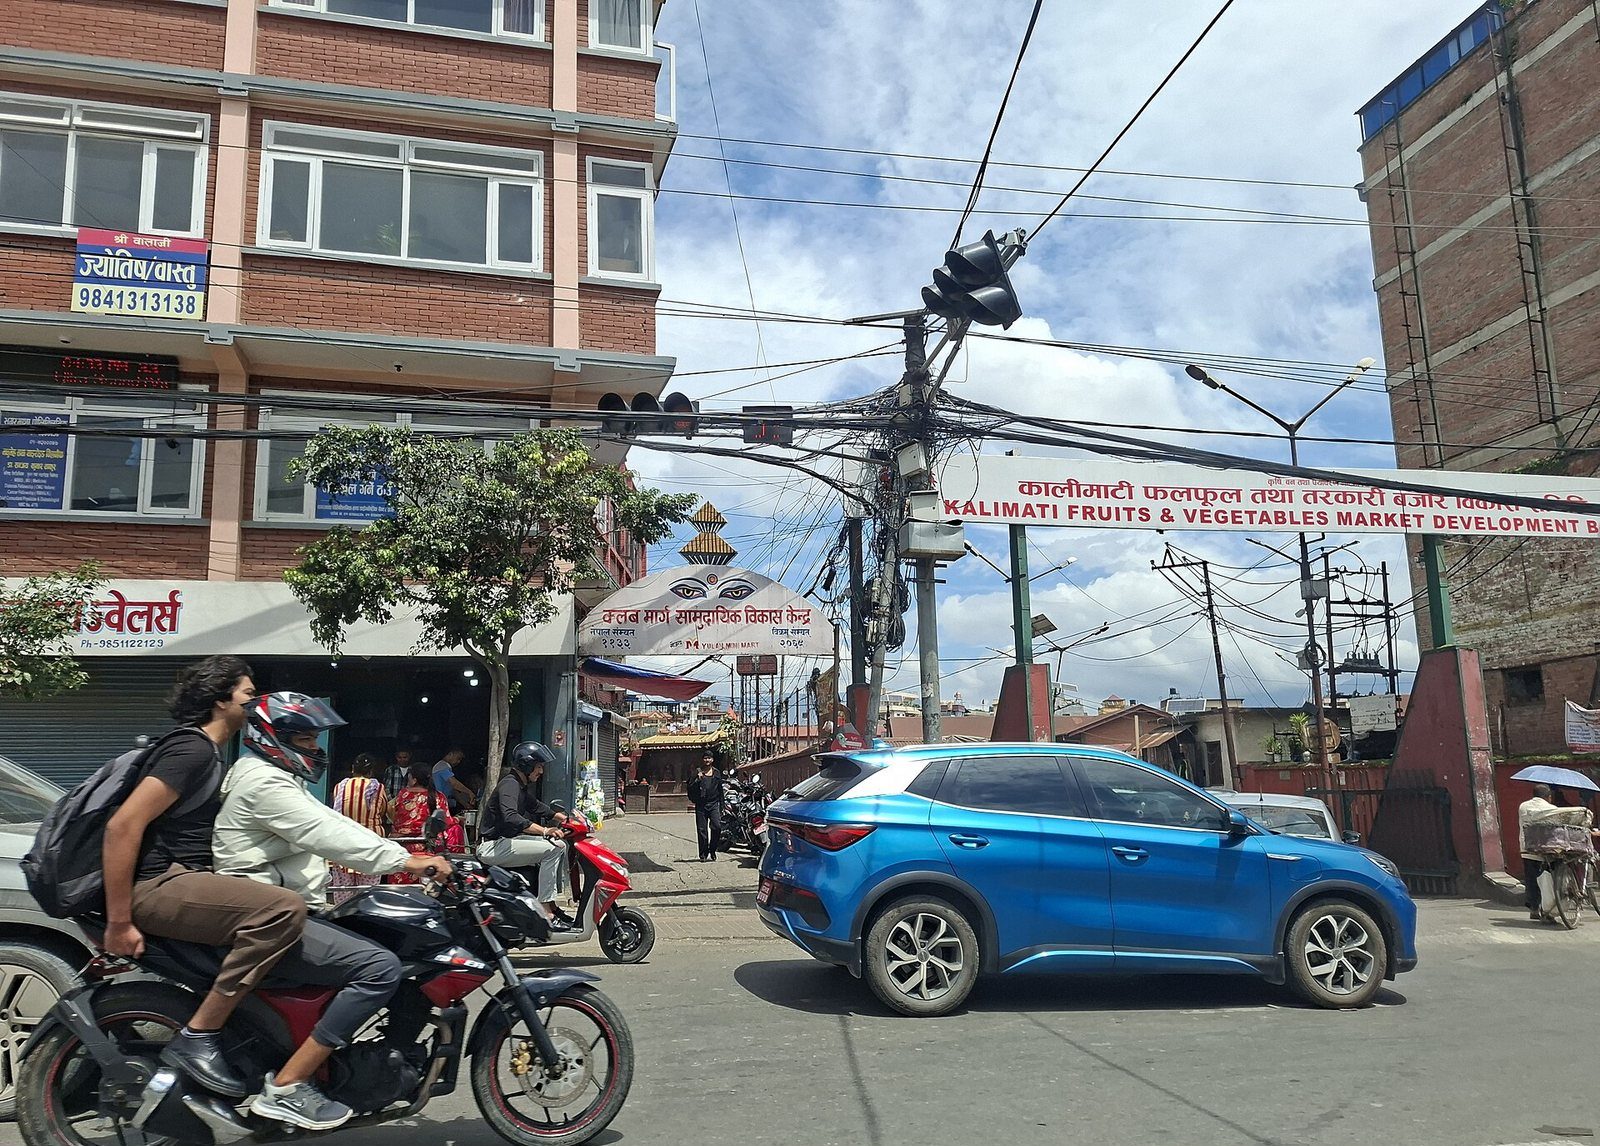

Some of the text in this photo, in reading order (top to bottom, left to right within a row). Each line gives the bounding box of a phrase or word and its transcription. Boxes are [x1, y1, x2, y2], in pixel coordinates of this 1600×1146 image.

[114, 233, 128, 244] श्री
[79, 287, 196, 315] 9841313138
[1017, 478, 1134, 500] कालीमाटी
[1143, 484, 1243, 507] फलफूल
[1249, 488, 1294, 504] तथा
[1302, 487, 1386, 507] तरकारी
[1393, 492, 1448, 510] बजार
[943, 499, 1058, 519] KALIMATI
[1067, 504, 1151, 522] FRUITS
[1160, 507, 1175, 523] &
[1183, 508, 1329, 525] VEGETABLES
[1337, 511, 1425, 528] MARKET
[1433, 514, 1579, 533] DEVELOPMENT
[643, 605, 670, 625] मार्ग
[675, 605, 742, 630] सामुदायिक
[744, 604, 784, 624] विकास
[785, 605, 812, 625] केन्द्र
[740, 641, 760, 649] MART
